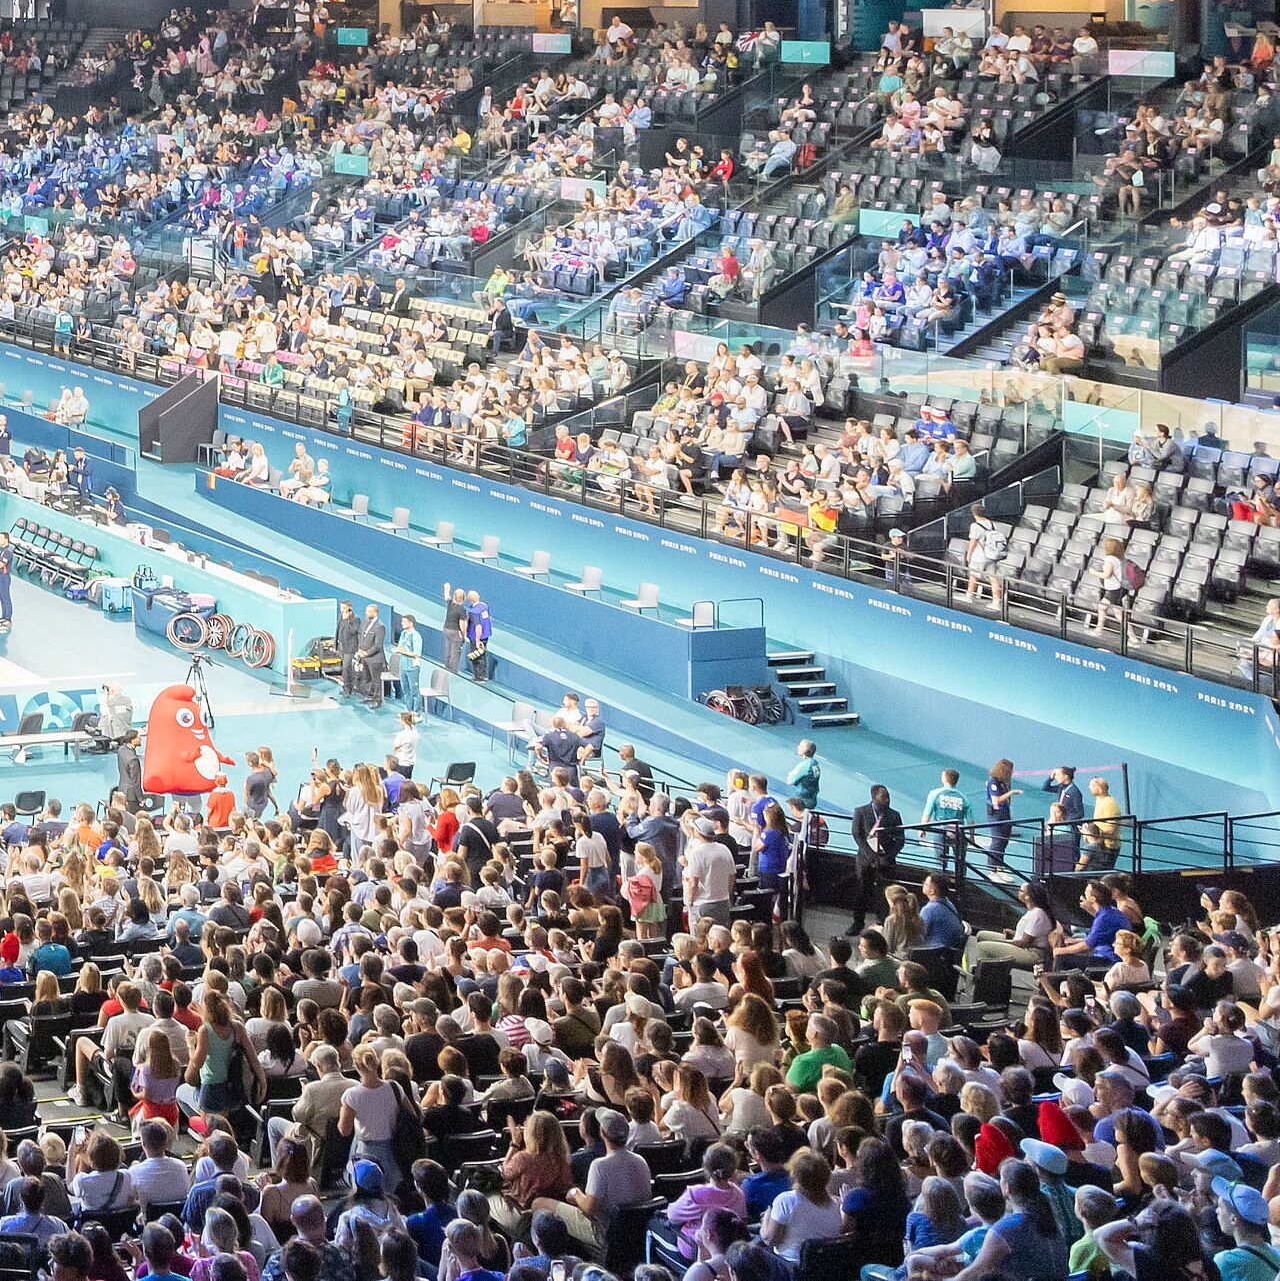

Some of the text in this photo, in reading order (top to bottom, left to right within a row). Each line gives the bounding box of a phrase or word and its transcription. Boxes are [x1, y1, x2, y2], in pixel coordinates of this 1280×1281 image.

[430, 472, 442, 480] 2024
[452, 480, 466, 488] PARIS
[490, 491, 519, 503] PARIS 2024
[531, 502, 561, 515] PARIS 2024
[572, 514, 604, 527] PARIS 2024
[616, 527, 649, 540] PARIS 2024
[661, 540, 696, 553] PARIS 2024
[709, 552, 746, 567] PARIS 2024
[760, 567, 798, 582] PARIS 2024
[813, 582, 853, 599] PARIS 2024
[869, 599, 911, 616] PARIS 2024
[927, 615, 972, 632] PARIS 2024
[989, 632, 1037, 652] PARIS 2024
[1055, 652, 1105, 671] PARIS 2024
[1125, 672, 1177, 693] PARIS 2024
[1199, 693, 1254, 714] PARIS 2024
